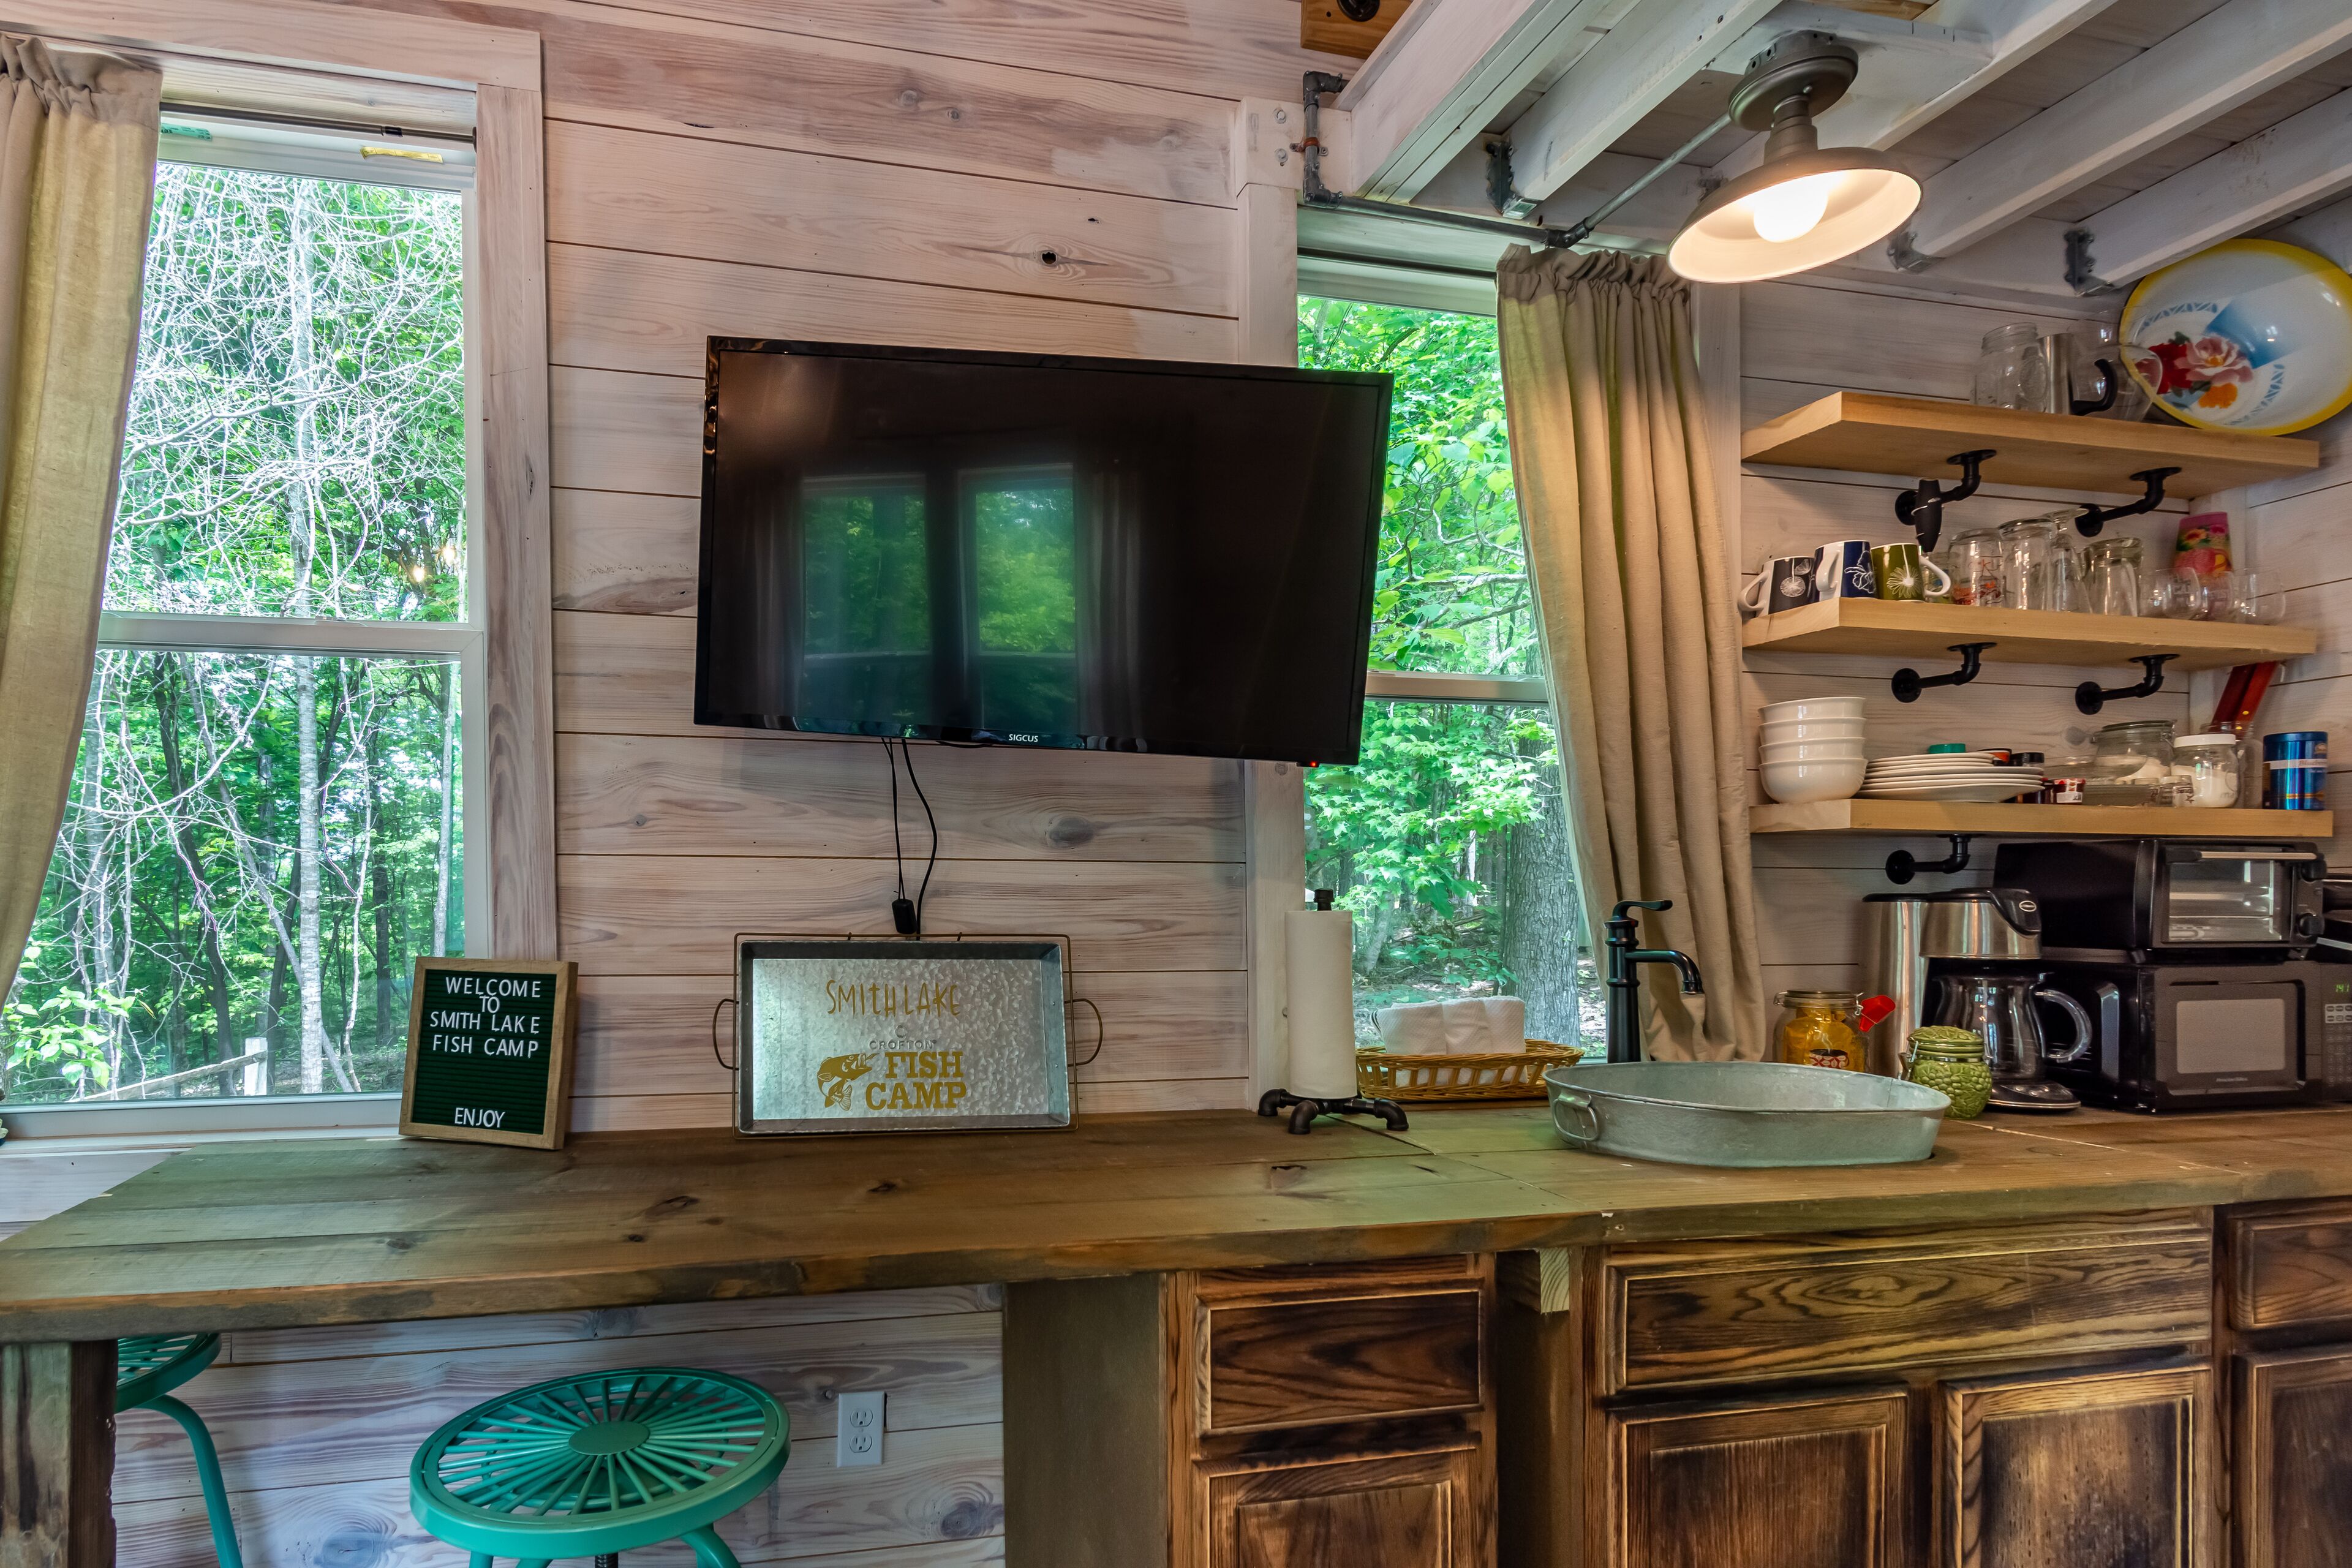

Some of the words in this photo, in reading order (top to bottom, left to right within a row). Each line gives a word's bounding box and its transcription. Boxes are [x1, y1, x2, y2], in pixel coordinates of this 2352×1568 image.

[1008, 734, 1039, 742] SIGCUS
[445, 976, 541, 998] WELCOME
[480, 995, 500, 1014] TO
[430, 1011, 481, 1030] SMITH
[491, 1014, 540, 1035] LAKE
[432, 1035, 473, 1054] FISH
[484, 1038, 538, 1059] CAMP
[884, 1050, 964, 1079] FISH
[865, 1081, 967, 1110] CAMP
[454, 1107, 505, 1128] ENJOY
